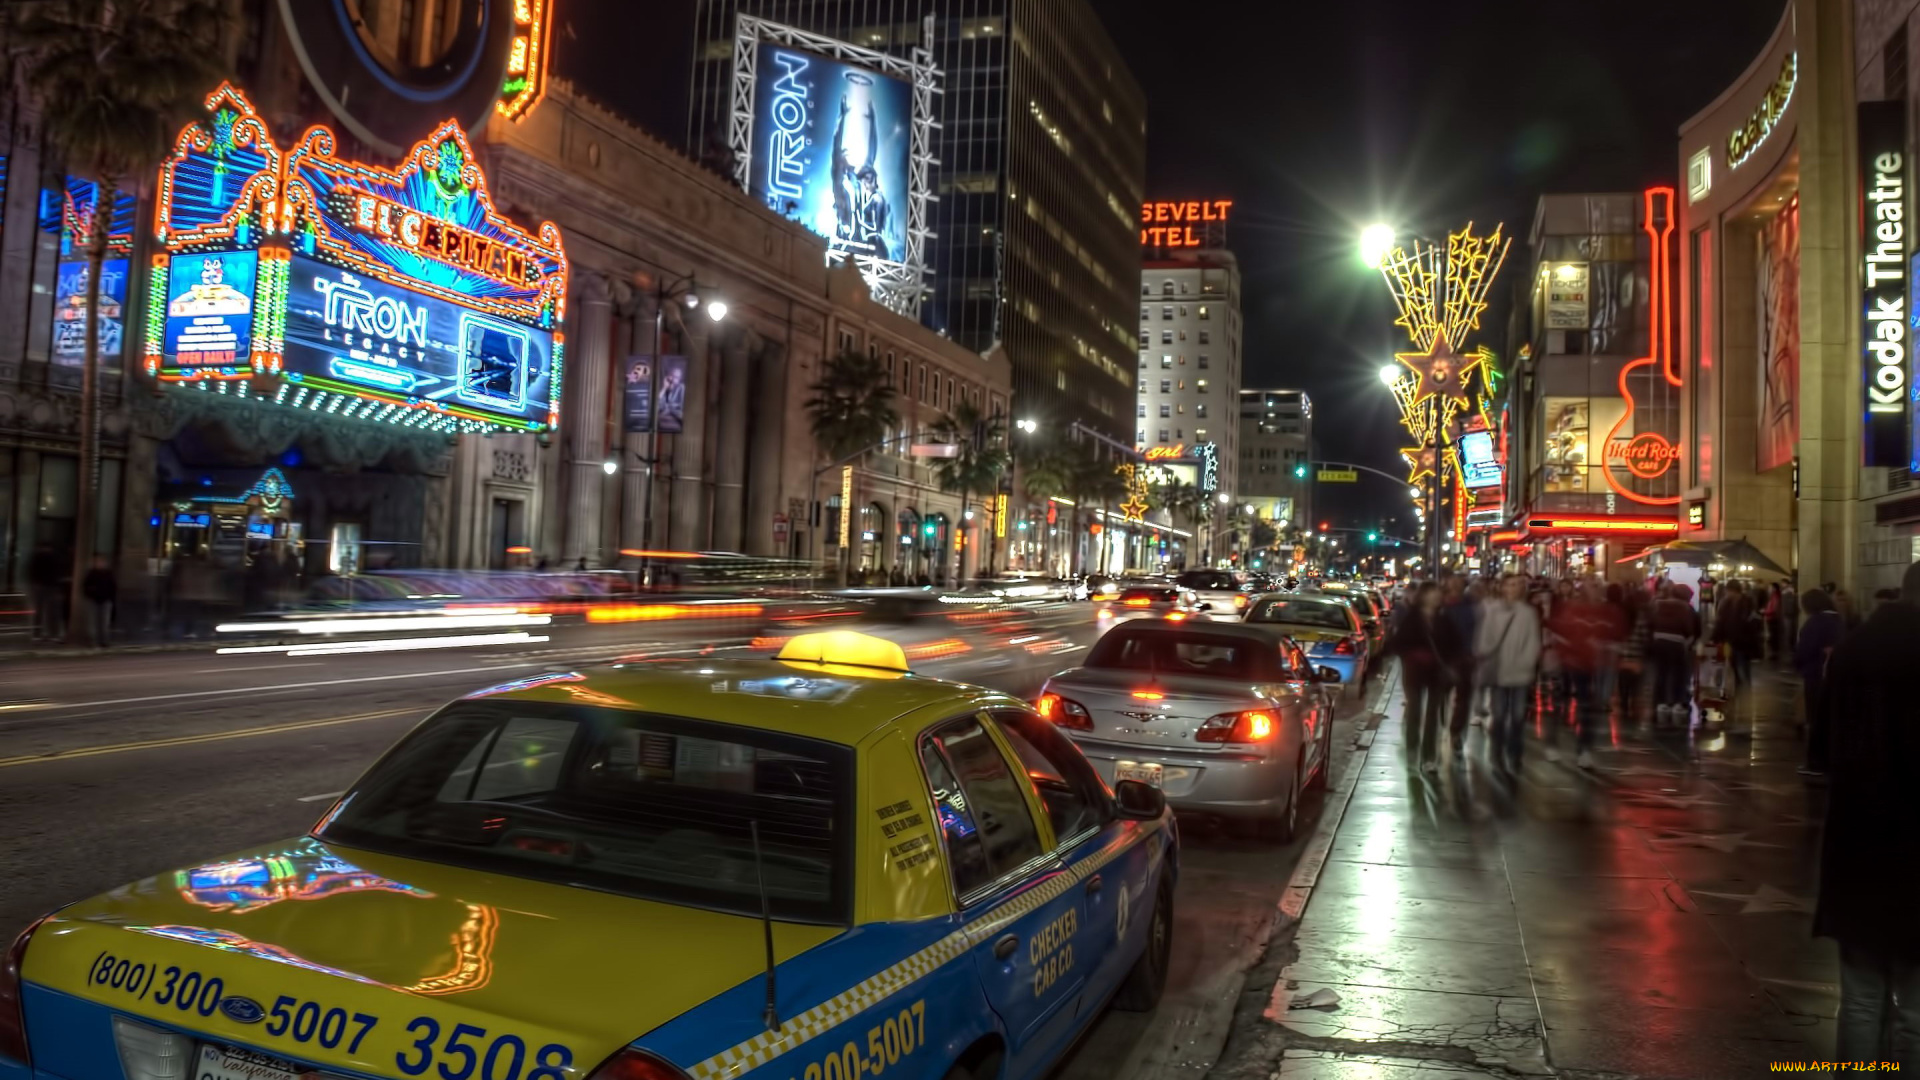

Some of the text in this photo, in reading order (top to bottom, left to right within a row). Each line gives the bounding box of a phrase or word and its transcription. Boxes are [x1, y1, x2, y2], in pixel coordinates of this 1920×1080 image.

[768, 52, 809, 209] TRON
[804, 80, 815, 185] LEGACY
[355, 193, 529, 288] EL CAPITAN
[313, 276, 430, 349] TRON
[1866, 150, 1905, 414] Kodak Theatre
[324, 328, 426, 362] LEGACY
[1608, 442, 1650, 459] Hard
[1029, 908, 1077, 965] CHECKER
[88, 950, 224, 1018] (800) 300
[1034, 964, 1057, 998] CAB
[265, 995, 378, 1055] 5007
[395, 1016, 574, 1080] 3508
[222, 1056, 292, 1080] California
